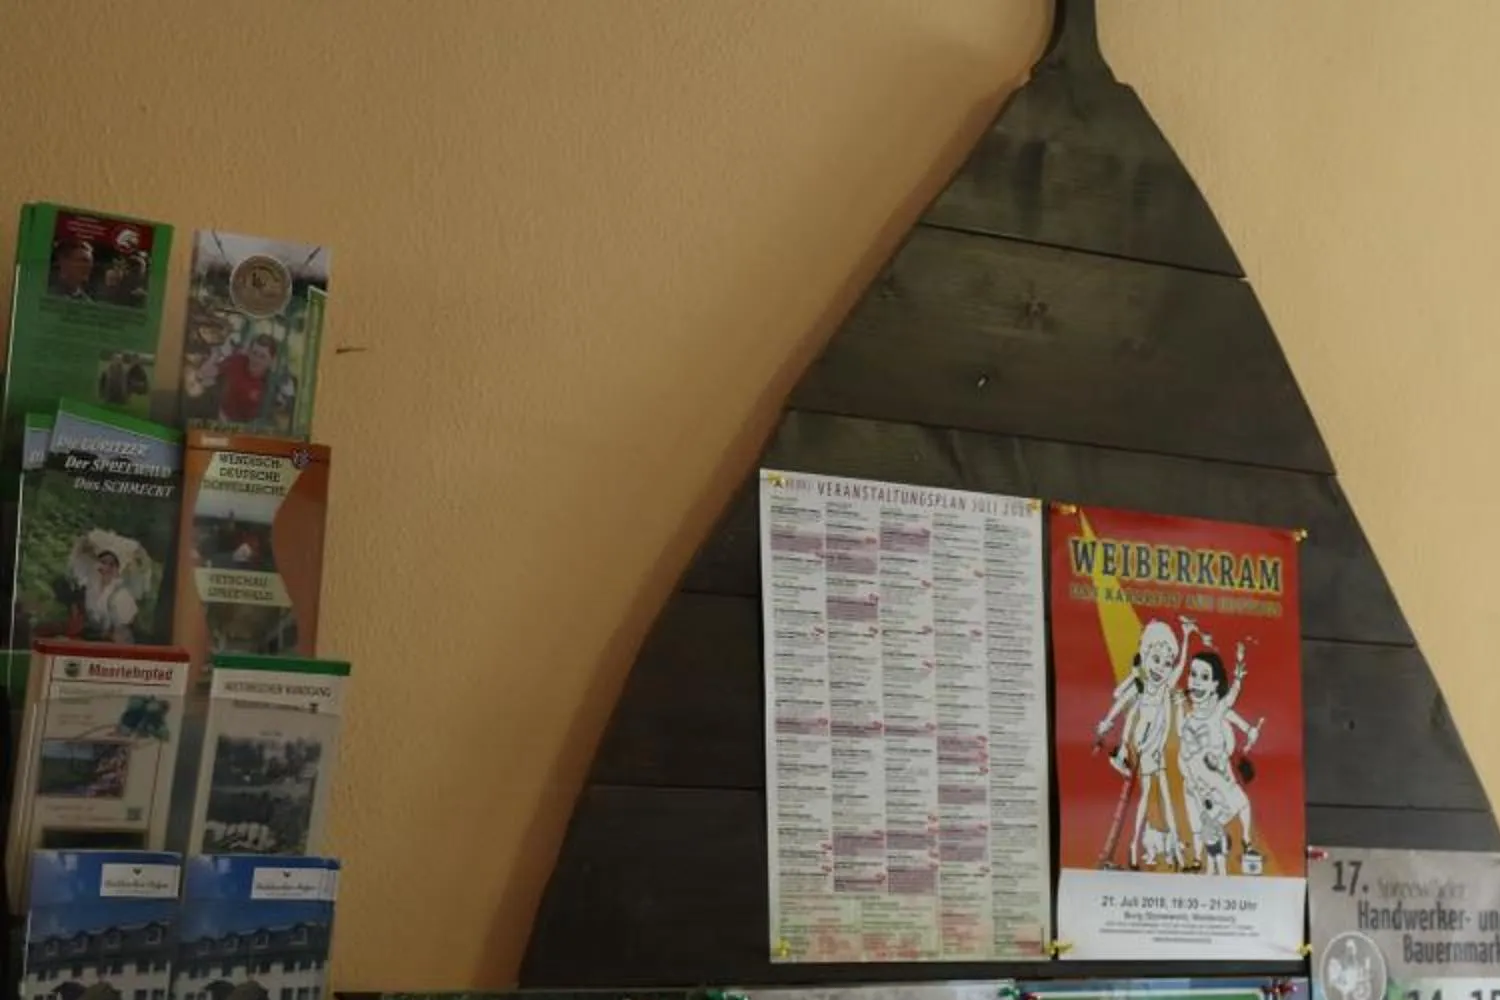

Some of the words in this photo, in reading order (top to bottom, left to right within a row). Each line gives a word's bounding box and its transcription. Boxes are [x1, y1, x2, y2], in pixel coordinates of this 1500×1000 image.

[817, 481, 966, 512] VERANSTALTUNGSPLAN
[1071, 538, 1282, 593] WEIBERKRAM
[1331, 861, 1369, 897] 17.
[1359, 901, 1472, 930] Handwerker-
